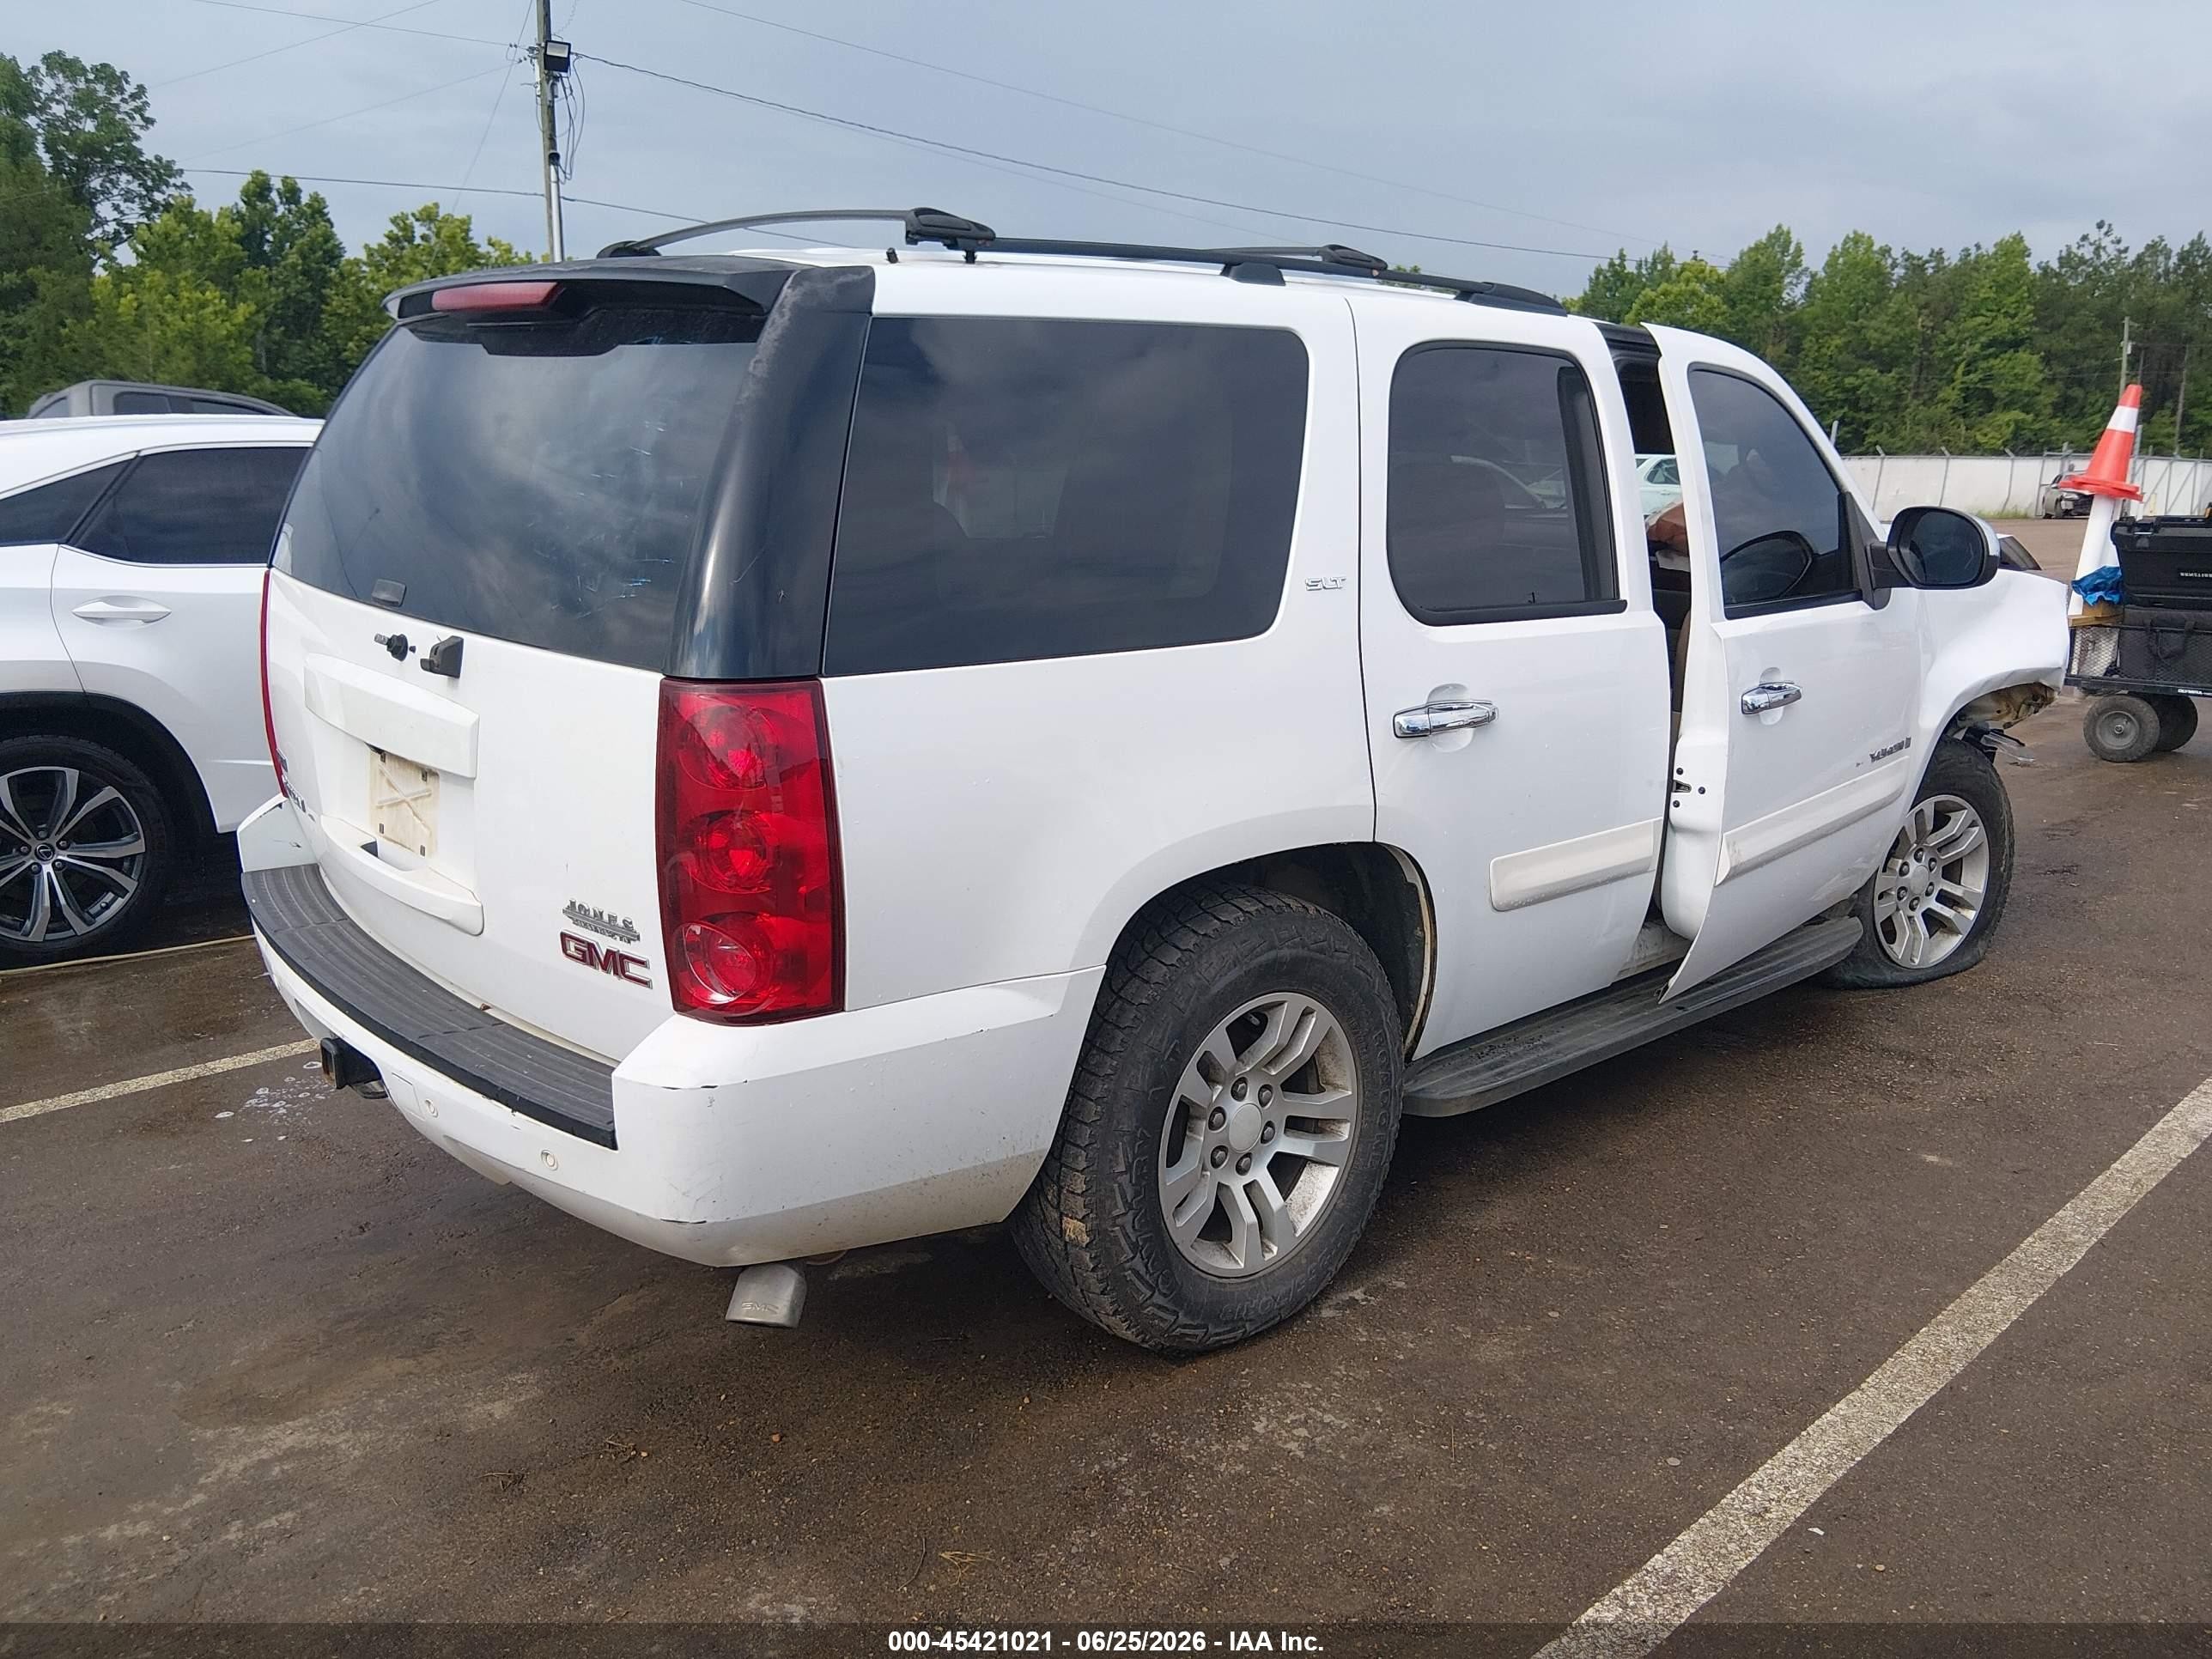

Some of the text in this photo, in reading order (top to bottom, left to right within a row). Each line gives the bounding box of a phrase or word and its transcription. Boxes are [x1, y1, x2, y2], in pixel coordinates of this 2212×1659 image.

[1304, 577, 1346, 591] SLT
[565, 898, 635, 932] JONES
[560, 930, 653, 989] GMC
